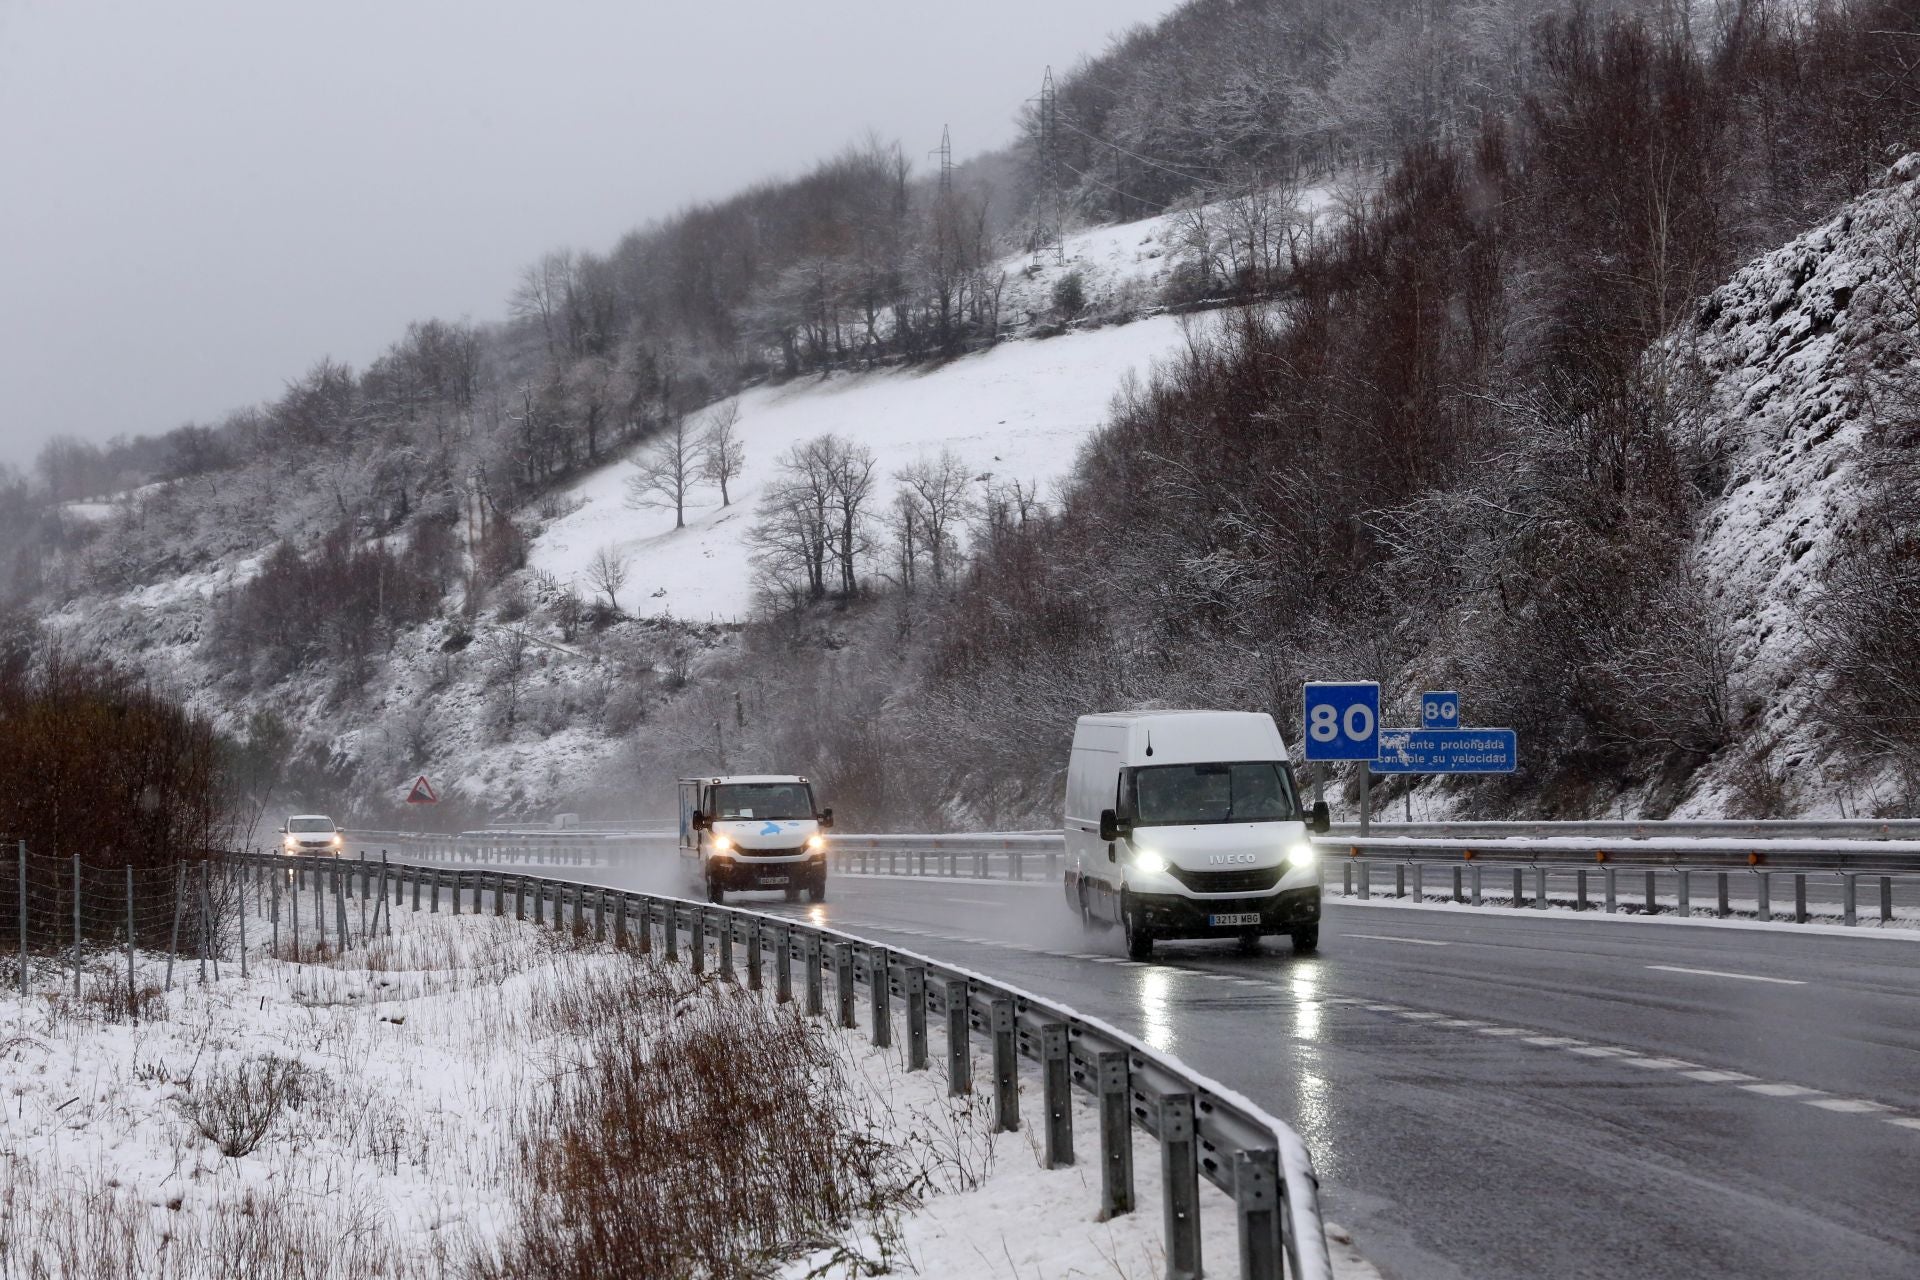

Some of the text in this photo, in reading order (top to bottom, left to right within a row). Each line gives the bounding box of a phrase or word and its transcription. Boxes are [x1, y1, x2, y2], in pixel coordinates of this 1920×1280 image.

[1424, 702, 1457, 720] 80
[1309, 703, 1374, 742] 80
[1441, 739, 1505, 752] prolongada
[1378, 753, 1507, 764] contole su velocidad
[1209, 853, 1256, 865] IVECO
[1216, 914, 1258, 925] 3213 MBG
